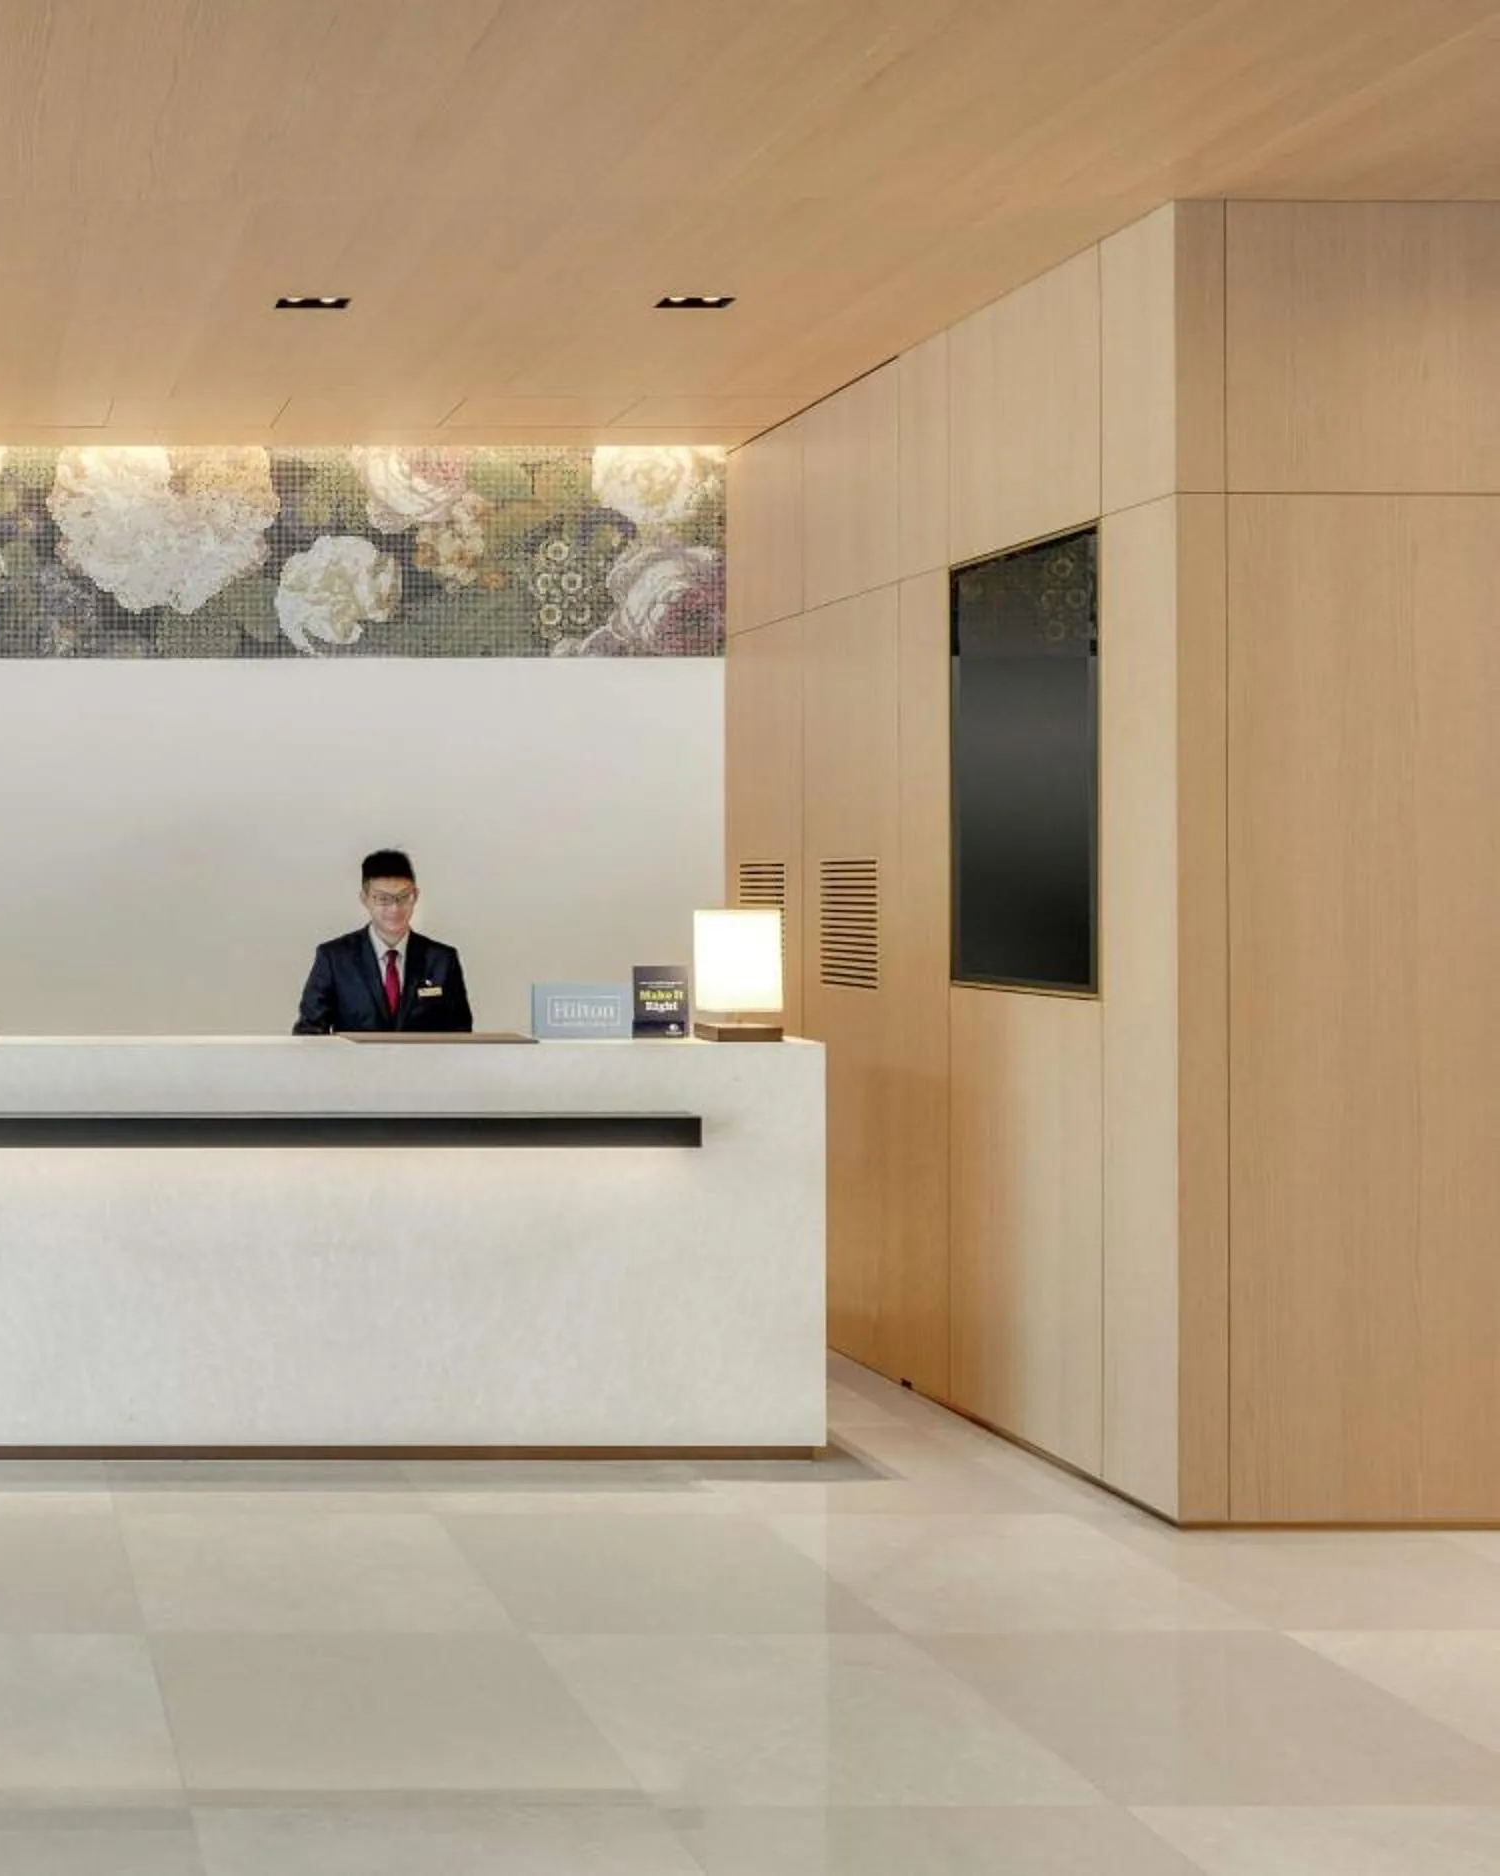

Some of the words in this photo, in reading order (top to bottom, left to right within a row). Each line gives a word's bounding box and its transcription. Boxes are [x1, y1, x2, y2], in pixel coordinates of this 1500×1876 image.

[640, 989, 673, 1000] Make
[553, 1000, 616, 1018] Hilton
[645, 1000, 679, 1013] Right
